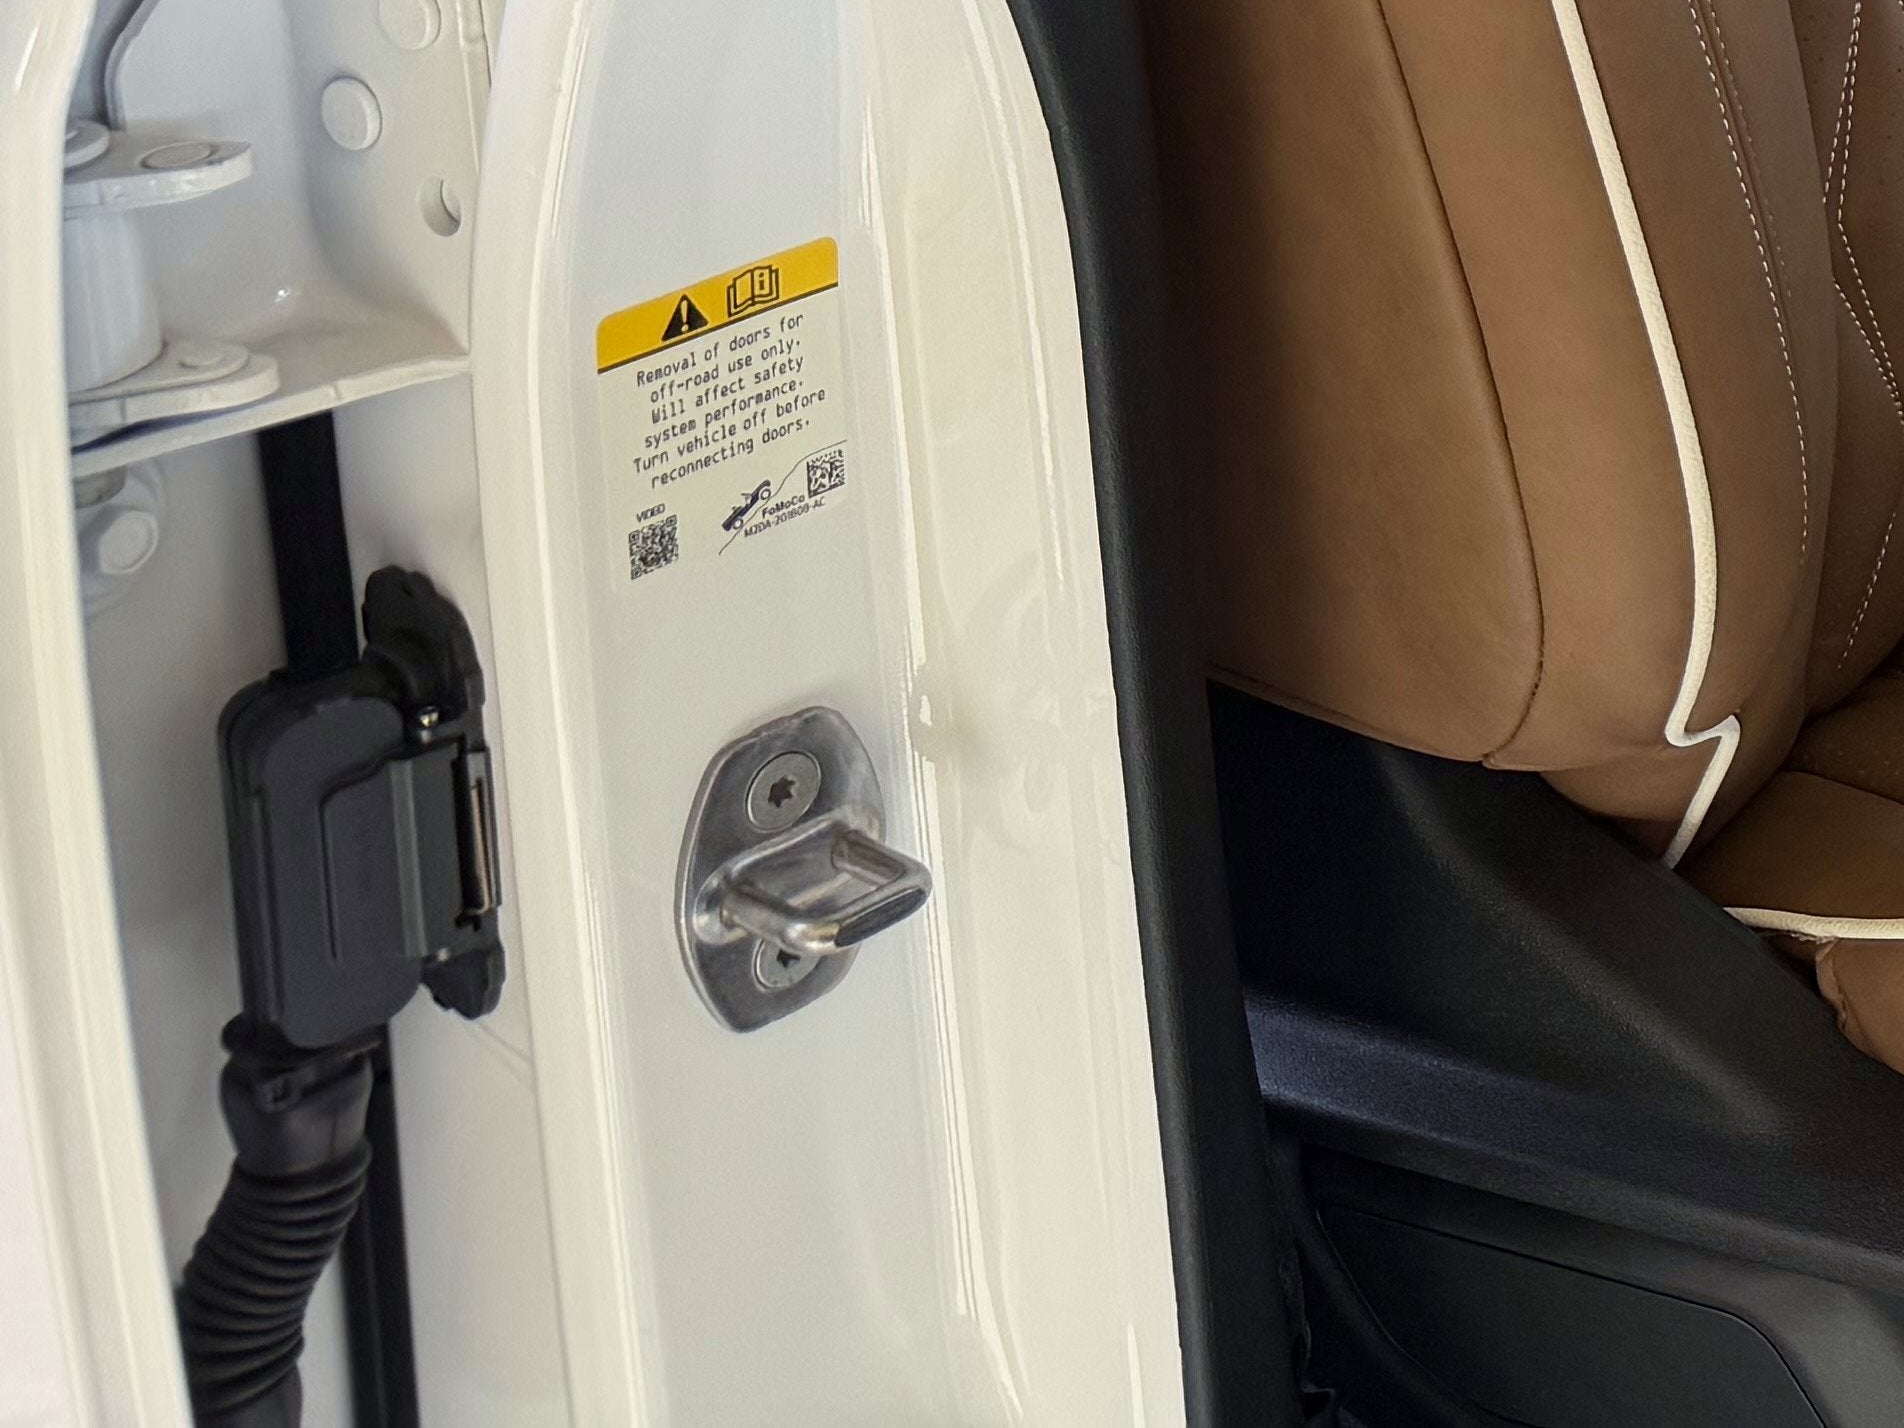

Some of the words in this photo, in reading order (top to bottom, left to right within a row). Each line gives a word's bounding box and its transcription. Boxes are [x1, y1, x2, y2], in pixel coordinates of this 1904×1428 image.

[636, 352, 696, 387] Removal
[704, 342, 720, 361] of
[729, 327, 771, 352] doors
[780, 313, 804, 332] for
[650, 364, 720, 403] off-road
[728, 355, 753, 374] use
[760, 339, 800, 361] only.
[644, 418, 696, 450] system
[705, 379, 803, 428] performance.
[651, 398, 686, 424] Will
[695, 377, 746, 407] affect
[754, 355, 804, 385] safety
[633, 451, 669, 474] Turn
[677, 424, 737, 457] vehicle
[743, 407, 767, 431] off
[776, 388, 826, 418] before
[651, 438, 754, 489] reconnecting
[762, 418, 810, 444] doors.
